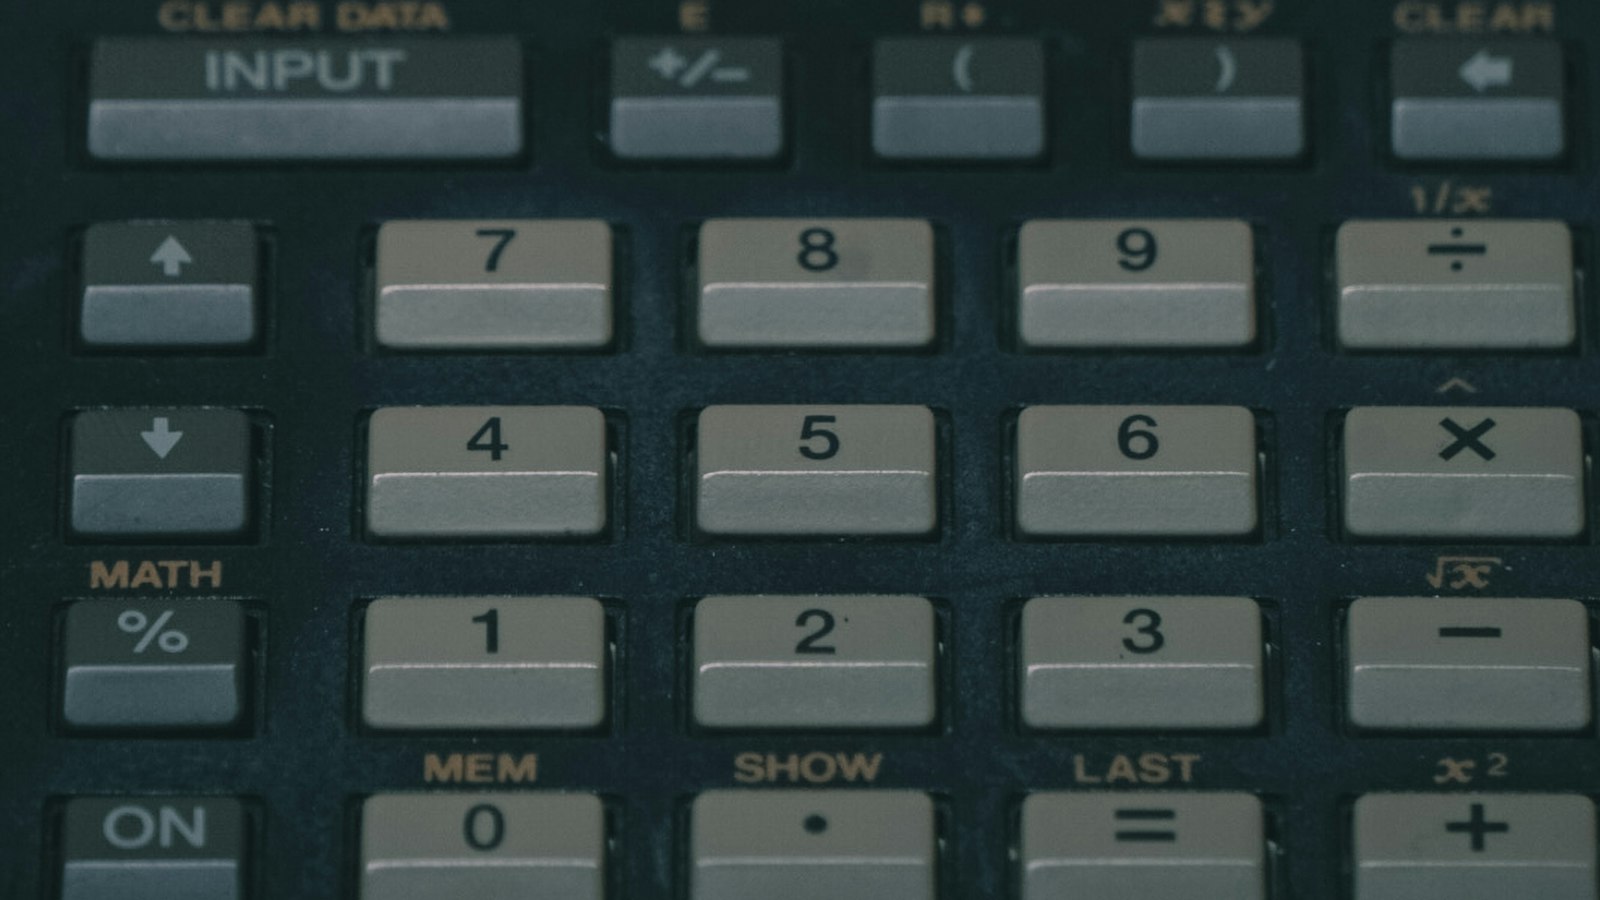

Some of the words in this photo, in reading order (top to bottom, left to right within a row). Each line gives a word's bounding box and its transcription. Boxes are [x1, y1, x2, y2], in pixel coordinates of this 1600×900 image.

[158, 1, 321, 30] CLEAR
[335, 1, 449, 29] DATA
[680, 1, 707, 29] E
[1394, 3, 1554, 31] CLEAR
[206, 50, 405, 90] INPUT
[476, 229, 516, 272] 7
[798, 228, 839, 272] 8
[1117, 228, 1157, 272] 9
[467, 417, 508, 461] 4
[799, 415, 840, 460] 5
[1118, 414, 1159, 460] 6
[90, 561, 222, 589] MATH
[117, 610, 189, 653] %
[472, 609, 499, 654] 1
[795, 609, 836, 654] 2
[1122, 608, 1165, 654] 3
[424, 754, 538, 782] MEM
[734, 753, 882, 782] SHOW
[1074, 754, 1200, 783] LAST
[103, 806, 206, 848] ON
[463, 804, 506, 851] 0
